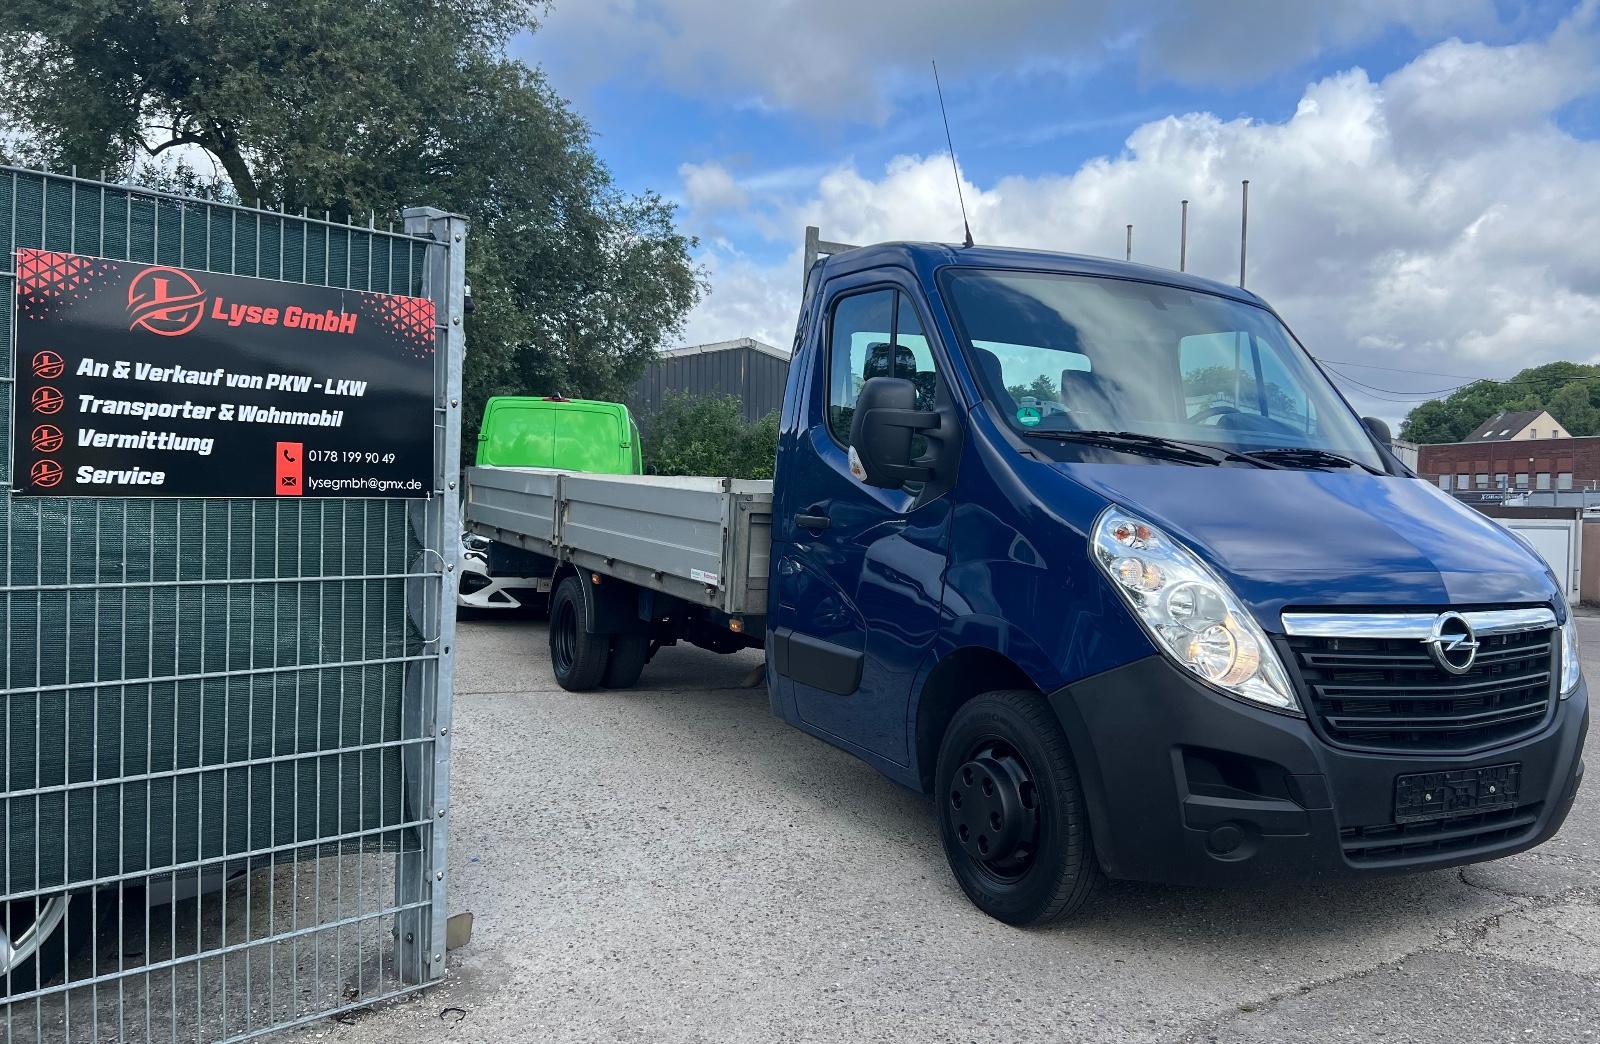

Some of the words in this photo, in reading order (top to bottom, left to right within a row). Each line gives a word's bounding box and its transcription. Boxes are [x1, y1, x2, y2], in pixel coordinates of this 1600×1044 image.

[211, 296, 279, 327] Lyse
[283, 305, 357, 334] GmbH
[76, 357, 110, 378] An
[112, 360, 131, 379] &
[135, 362, 225, 387] Verkauf
[226, 373, 263, 389] von
[265, 373, 312, 393] PKW
[324, 378, 367, 397] LKW
[78, 394, 216, 420] Transporter
[218, 403, 235, 421] &
[238, 404, 344, 427] Wohnmobil
[77, 428, 215, 456] Vermittlung
[308, 450, 338, 462] 0178
[343, 451, 362, 463] 199
[365, 452, 379, 464] 90
[381, 453, 396, 464] 49
[75, 465, 166, 486] Service
[308, 476, 422, 492] lysegmbh@gmx.de
